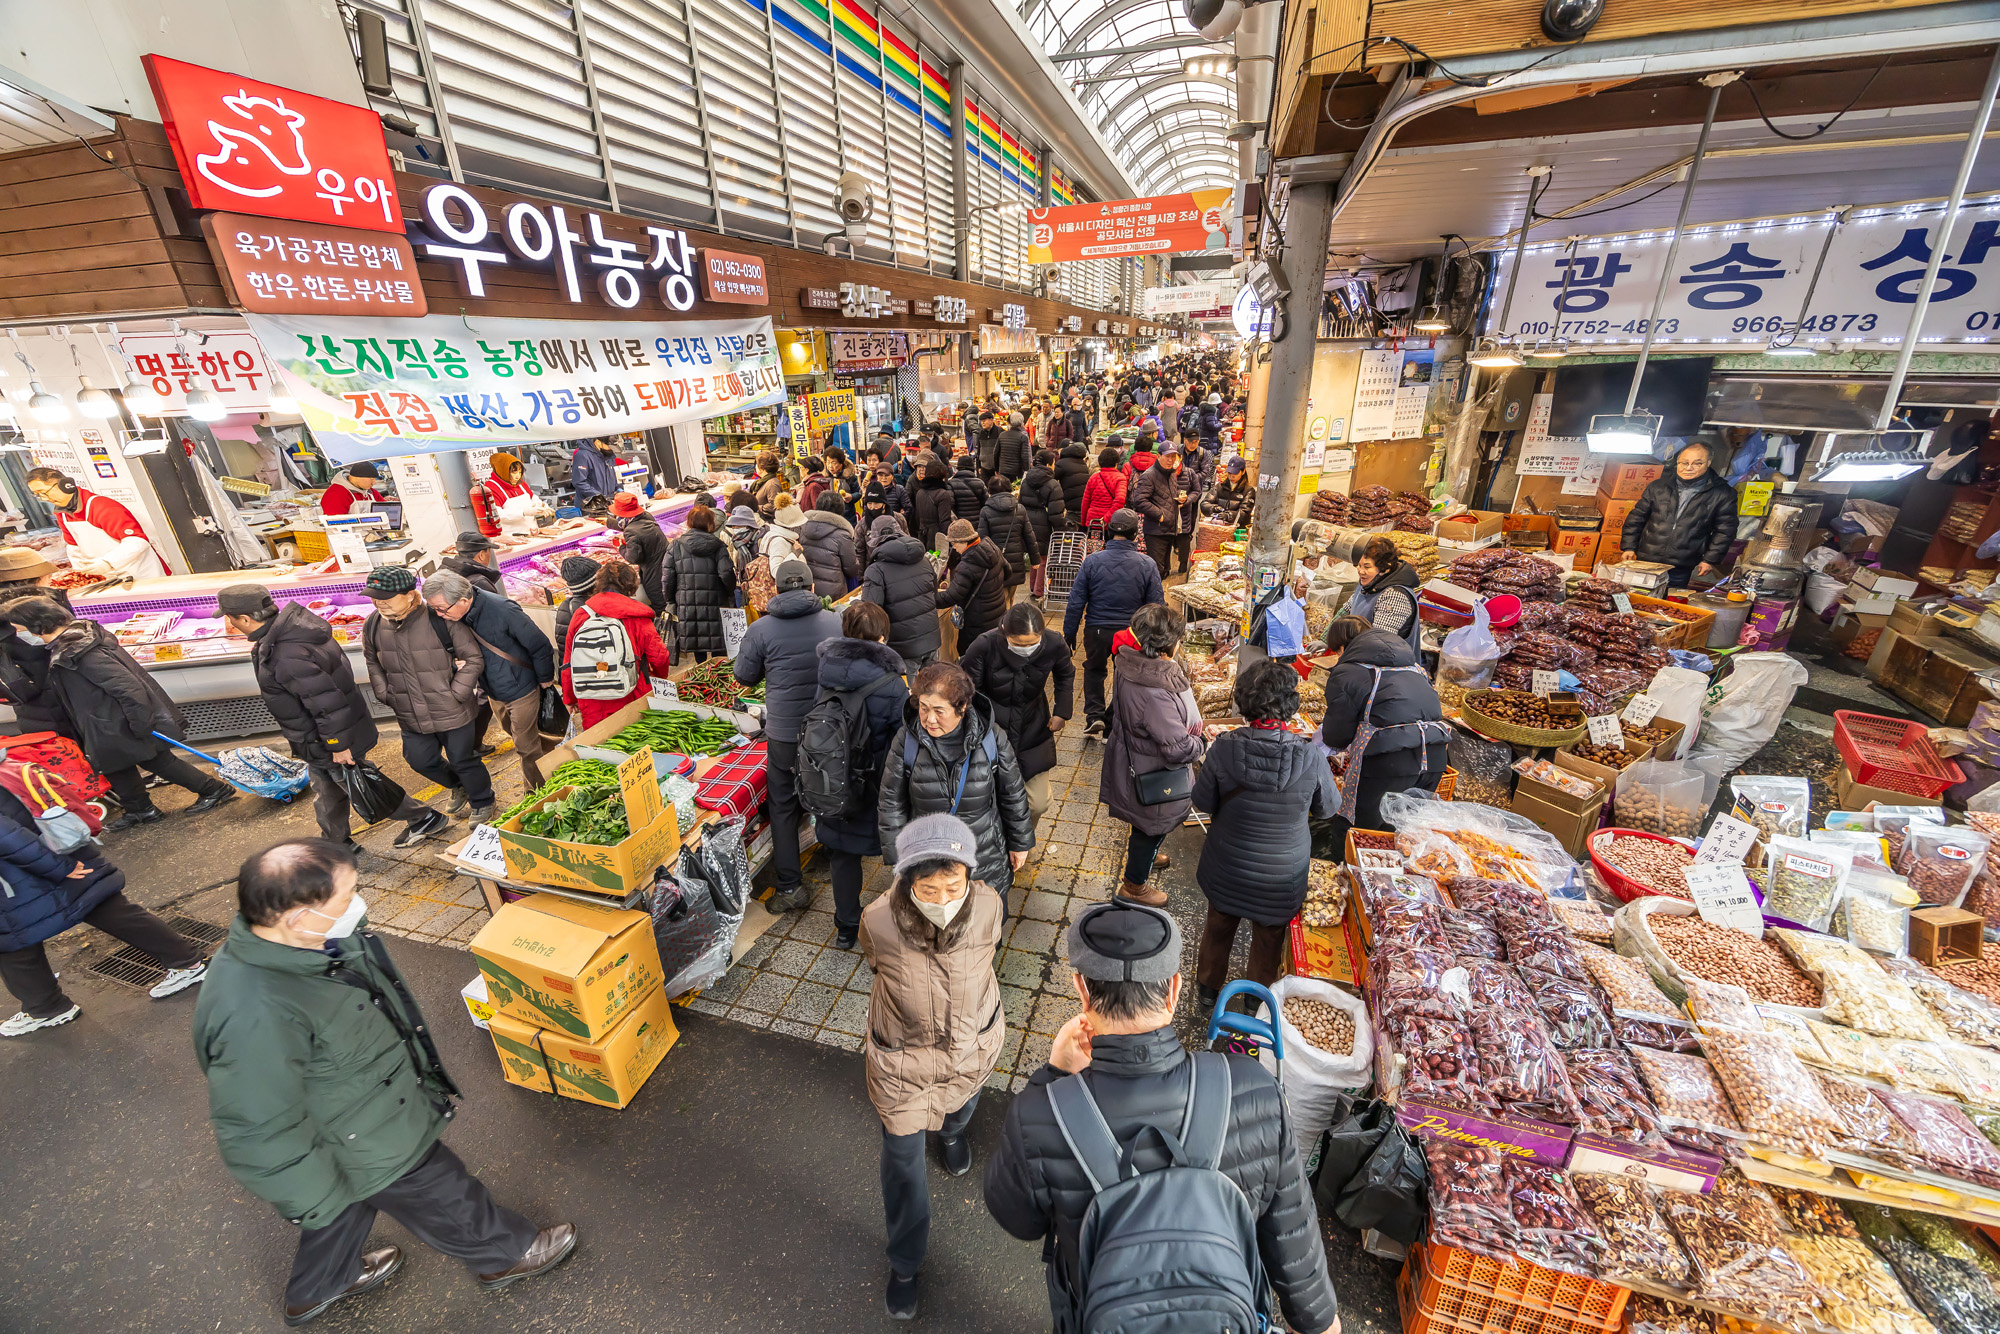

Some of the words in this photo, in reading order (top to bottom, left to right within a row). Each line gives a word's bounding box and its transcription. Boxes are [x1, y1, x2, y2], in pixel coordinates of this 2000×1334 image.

[316, 168, 393, 223] 우아
[1056, 222, 1084, 234] 서울시
[1086, 218, 1115, 231] 디자인
[1116, 216, 1136, 228] 혁신
[1137, 212, 1176, 226] 전통시장
[1178, 209, 1200, 222] 조성
[1205, 211, 1222, 227] 축
[1035, 228, 1051, 244] 경
[1096, 229, 1134, 241] 공모사업
[1136, 226, 1156, 238] 선정
[235, 231, 403, 271] 육가공전문업체
[424, 184, 698, 312] 우아농장
[711, 258, 725, 276] 02)
[725, 261, 762, 280] 962-0300
[246, 271, 415, 304] 한우.한돈.부산물
[1519, 318, 1680, 335] 010-7752-4873
[1731, 313, 1878, 333] 966-4873
[296, 333, 439, 380] 산지직송
[475, 338, 598, 379] 농장에서
[600, 338, 651, 371] 바로
[654, 336, 713, 368] 우리집
[715, 333, 771, 363] 식탁으로
[843, 336, 899, 359] 진광젓갈
[1381, 353, 1387, 362] 2
[134, 350, 263, 396] 명품한우
[835, 380, 856, 388] 창신푸드
[343, 391, 440, 436] 직접
[633, 377, 708, 412] 도매가로
[712, 363, 783, 403] 판매합니다
[1411, 387, 1415, 395] 2
[811, 393, 854, 418] 홍어회무침
[792, 409, 810, 457] 홍어무침
[511, 936, 556, 958] 감사합니다
[1410, 1114, 1539, 1160] Primavera
[1513, 1120, 1556, 1134] WALNUTS
